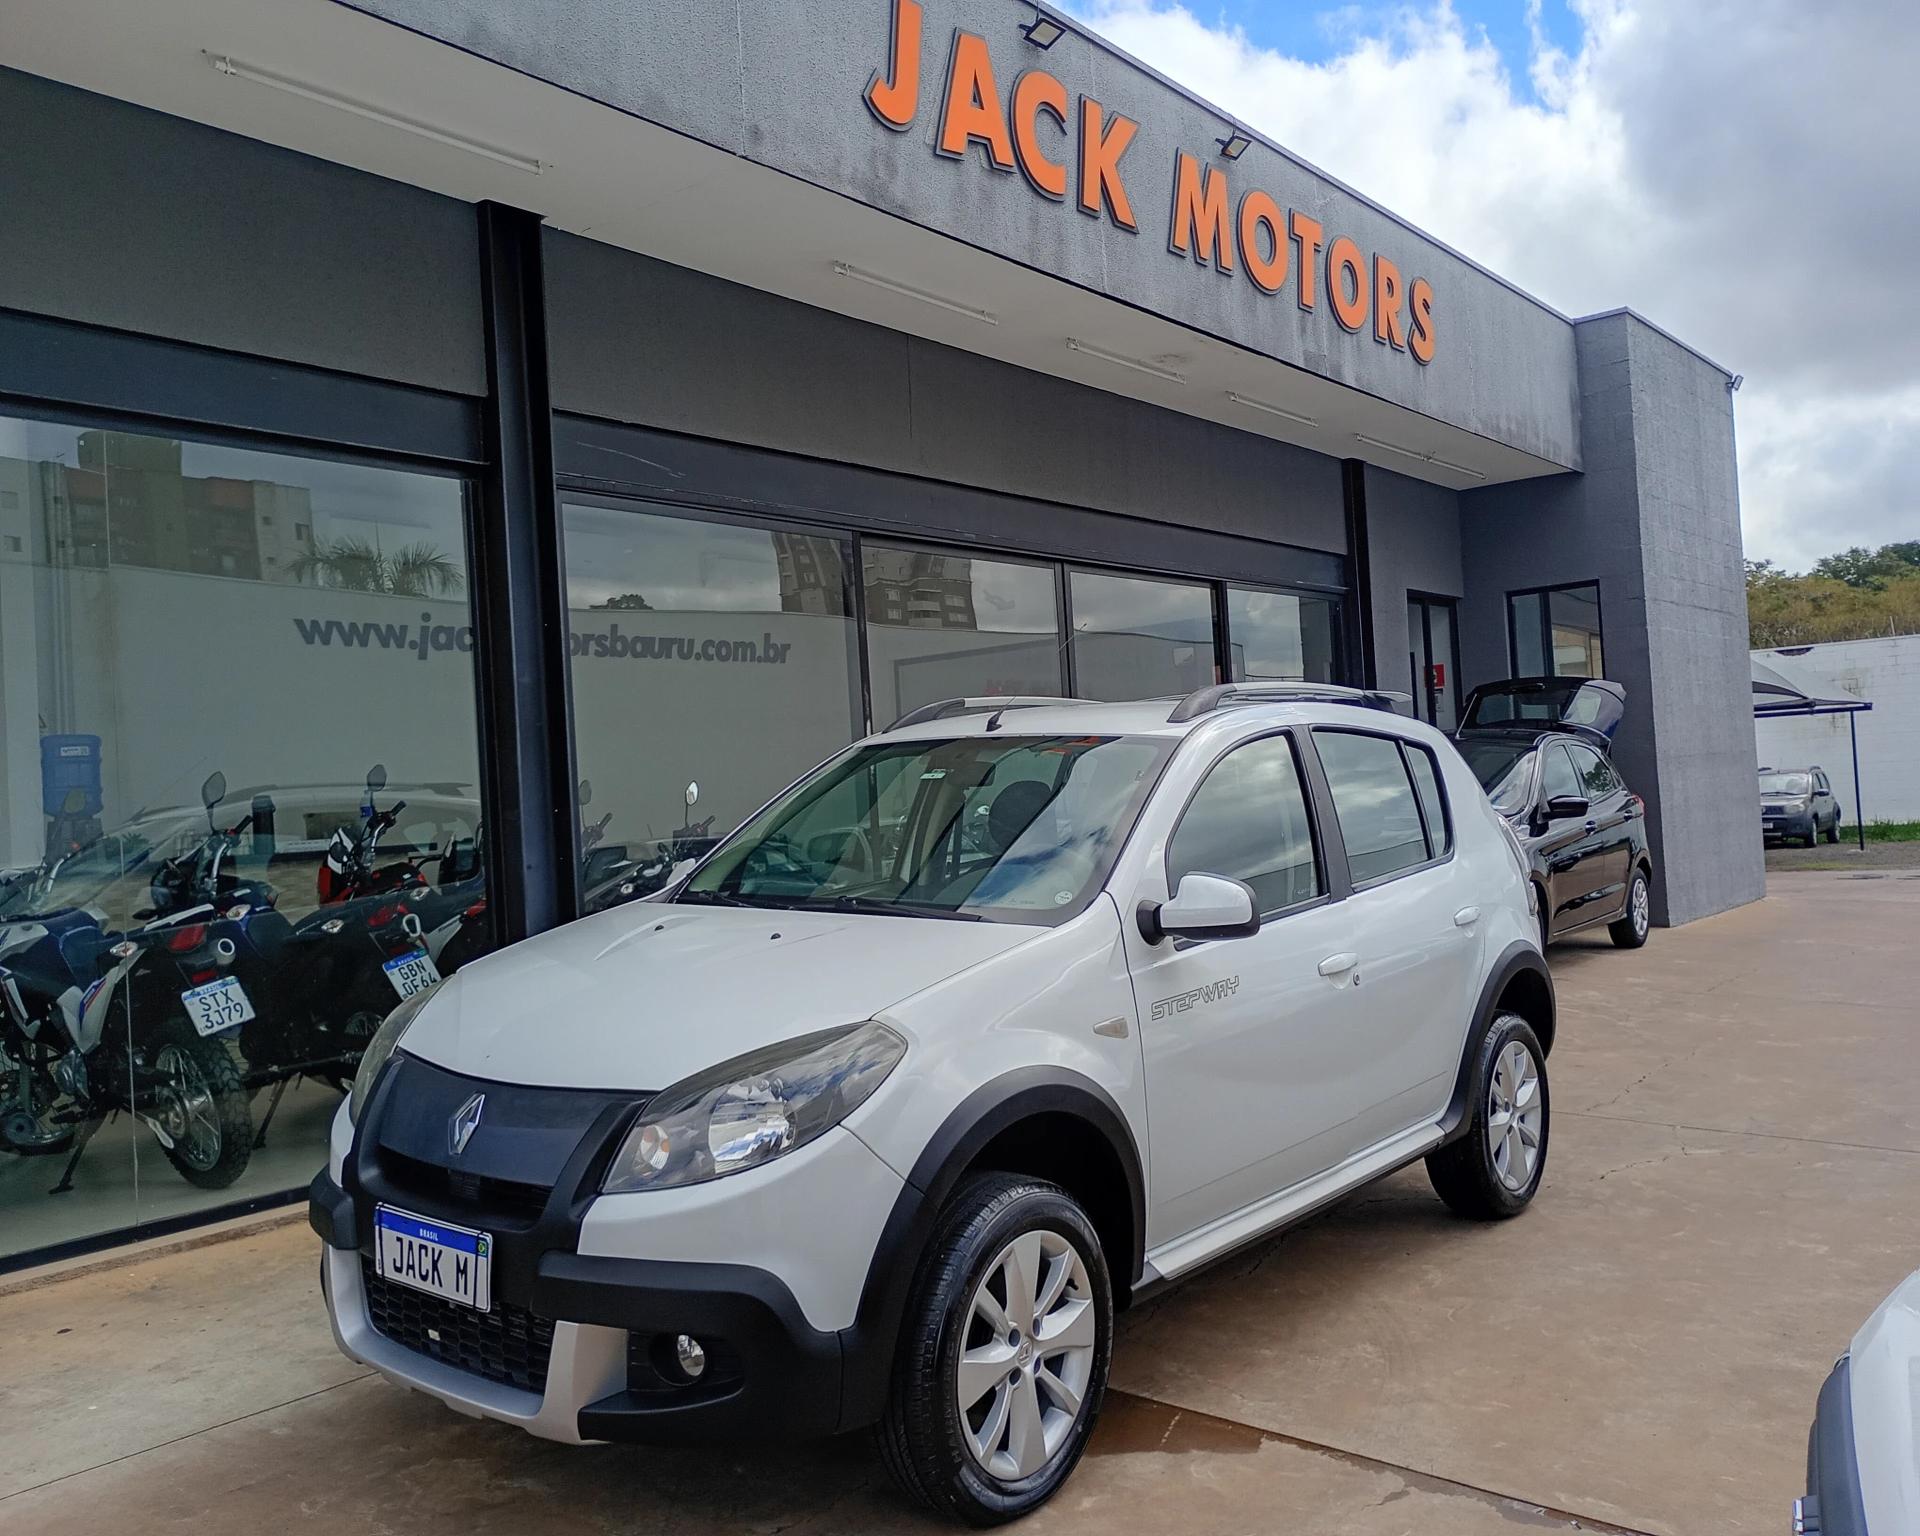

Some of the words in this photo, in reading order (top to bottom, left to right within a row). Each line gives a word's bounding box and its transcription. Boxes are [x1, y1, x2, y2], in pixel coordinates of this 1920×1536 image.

[863, 0, 1139, 234] JACK
[1168, 147, 1435, 366] MOTORS
[398, 960, 427, 981] GBN
[198, 988, 234, 1012] STX
[201, 1002, 244, 1029] 3J79
[1151, 975, 1240, 1021] STEPWAY
[393, 1236, 443, 1288] JACK
[455, 1253, 468, 1296] M
